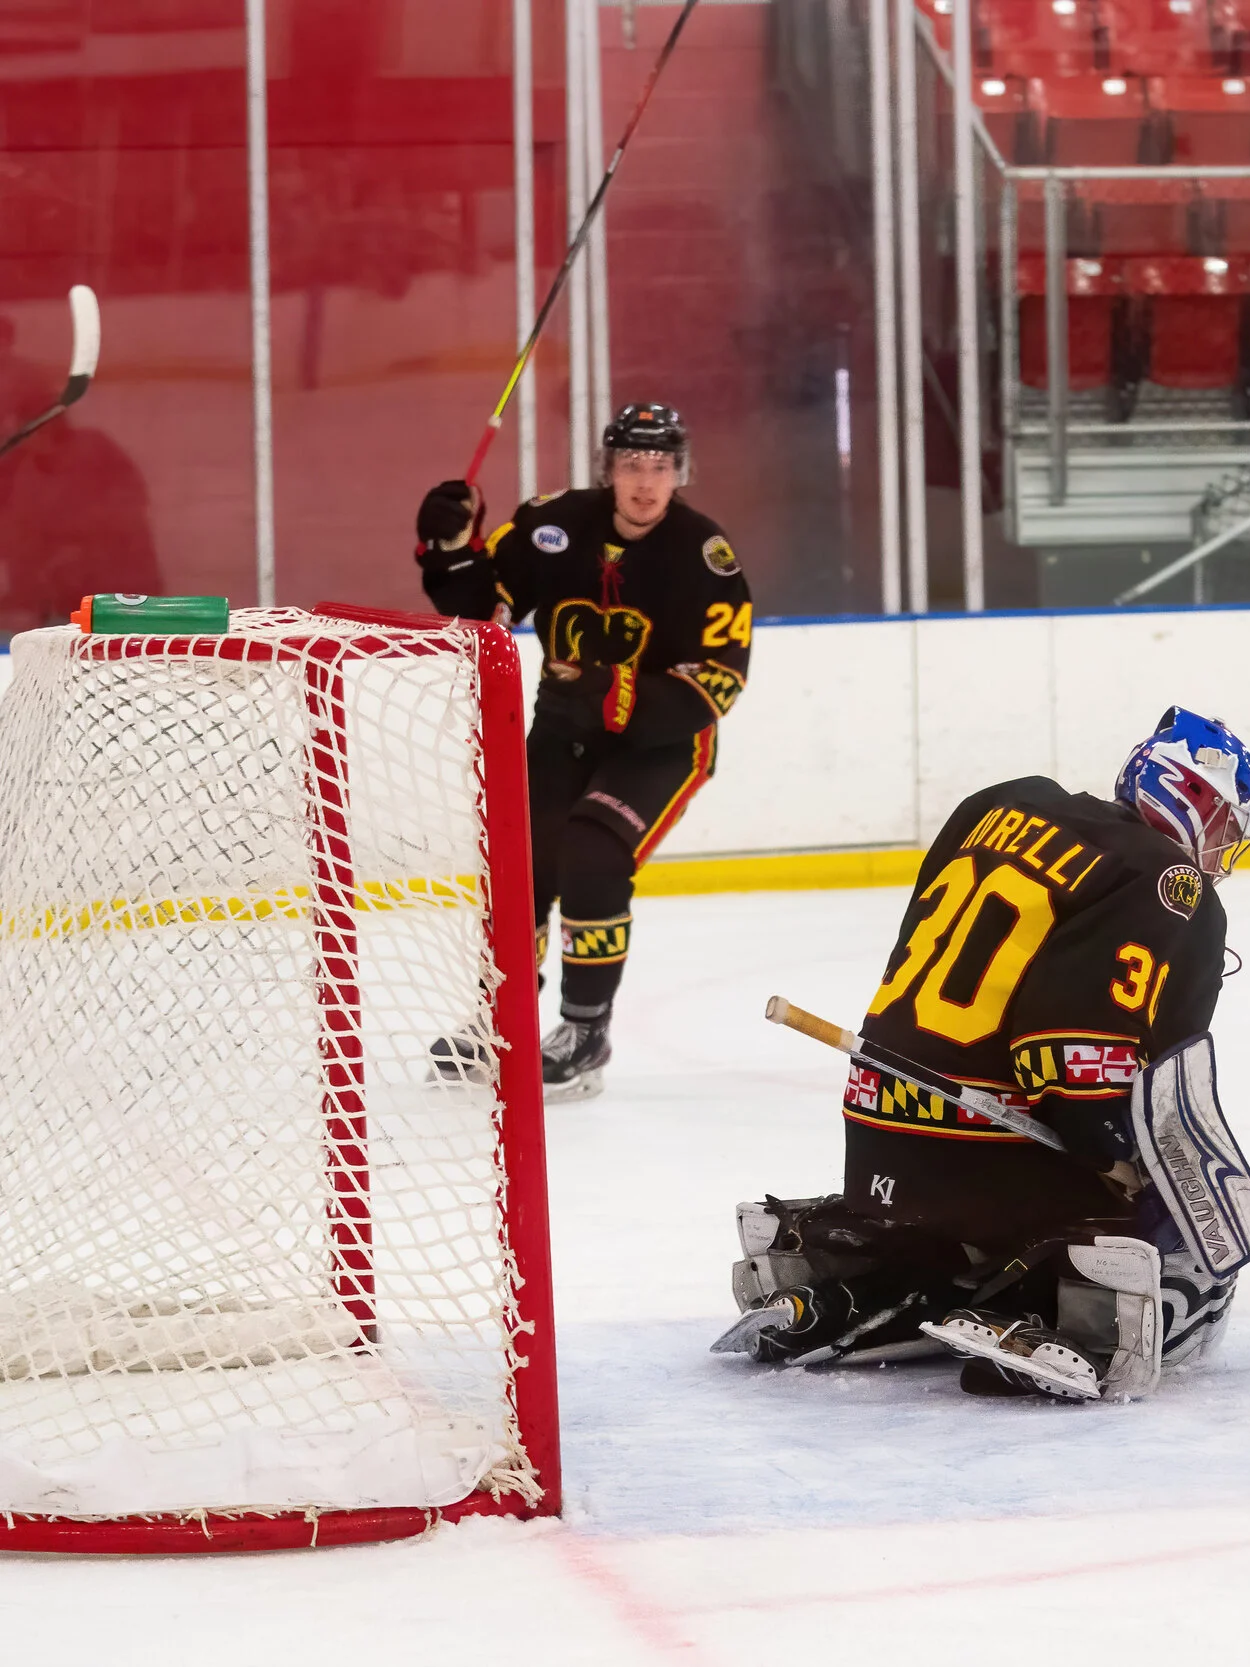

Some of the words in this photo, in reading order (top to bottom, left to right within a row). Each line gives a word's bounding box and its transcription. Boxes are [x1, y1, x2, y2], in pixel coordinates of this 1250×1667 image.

[702, 602, 753, 649] 24
[866, 854, 1057, 1047] 30
[1158, 1134, 1230, 1266] VAUGHN
